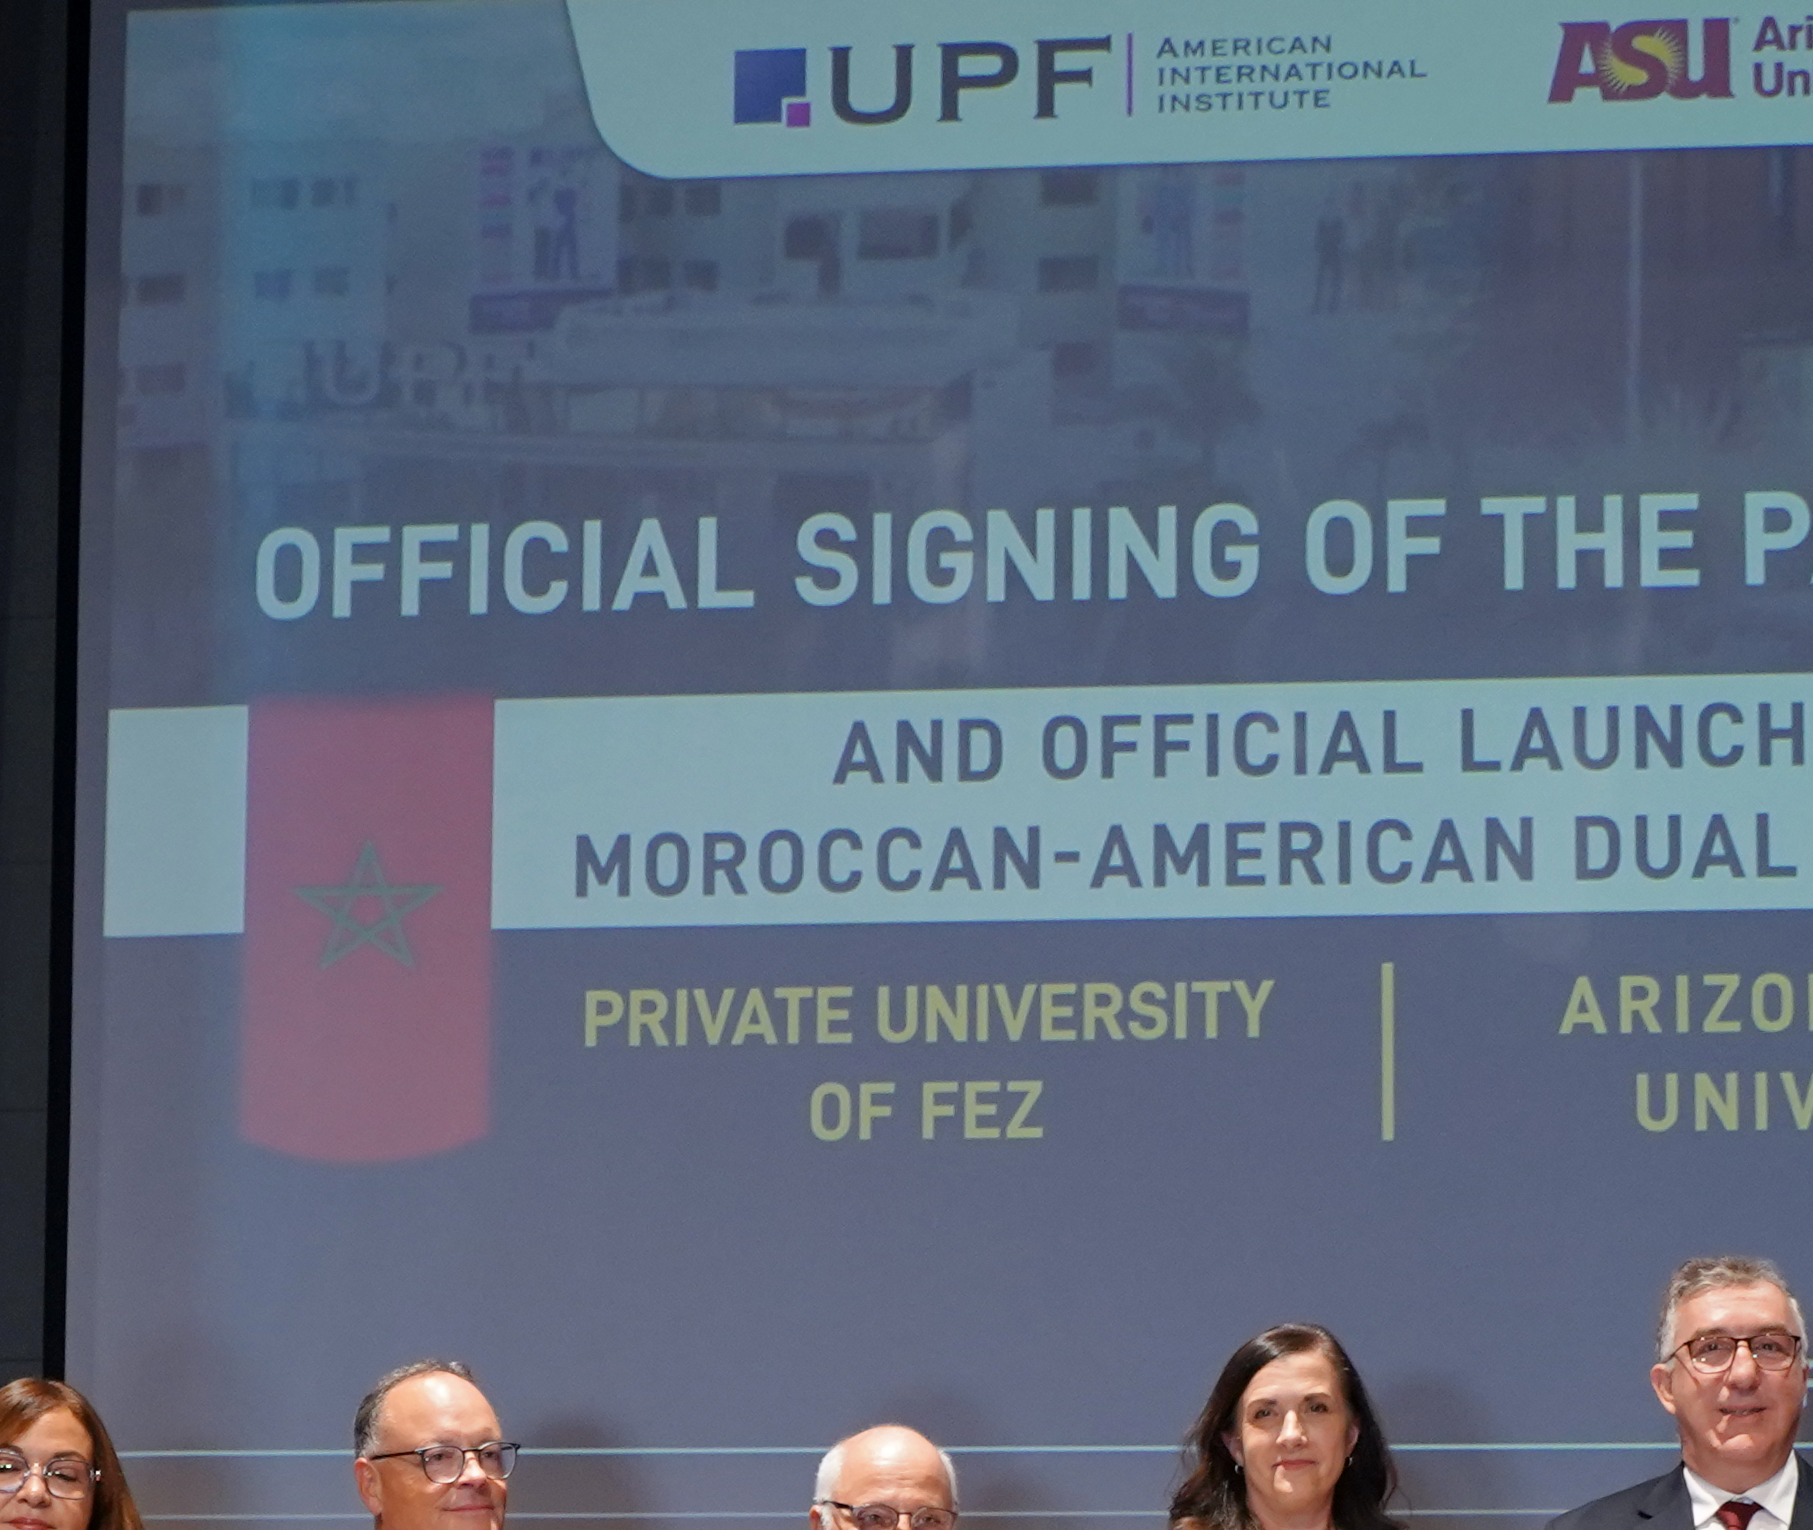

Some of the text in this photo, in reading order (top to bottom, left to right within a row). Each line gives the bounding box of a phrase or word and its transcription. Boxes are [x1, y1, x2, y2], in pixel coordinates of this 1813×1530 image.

[830, 35, 1111, 125] UPF
[1156, 35, 1331, 59] AMERICAN
[1159, 60, 1427, 86] INTERNATIONAL
[1548, 18, 1734, 103] ASU
[1159, 89, 1330, 113] INSTITUTE
[257, 517, 754, 619] OFFICIAL
[795, 504, 1259, 606] SIGNING
[1306, 499, 1446, 594] OF
[1481, 493, 1700, 590] THE
[833, 719, 1002, 784] AND
[1040, 706, 1423, 780] OFFICIAL
[1461, 702, 1804, 772] LAUNCH
[576, 817, 1533, 898] MOROCCAN-AMERICAN
[1575, 813, 1797, 880] DUAL
[585, 980, 1274, 1047] PRIVATE UNIVERSITY
[811, 1081, 1043, 1140] OF FEZ
